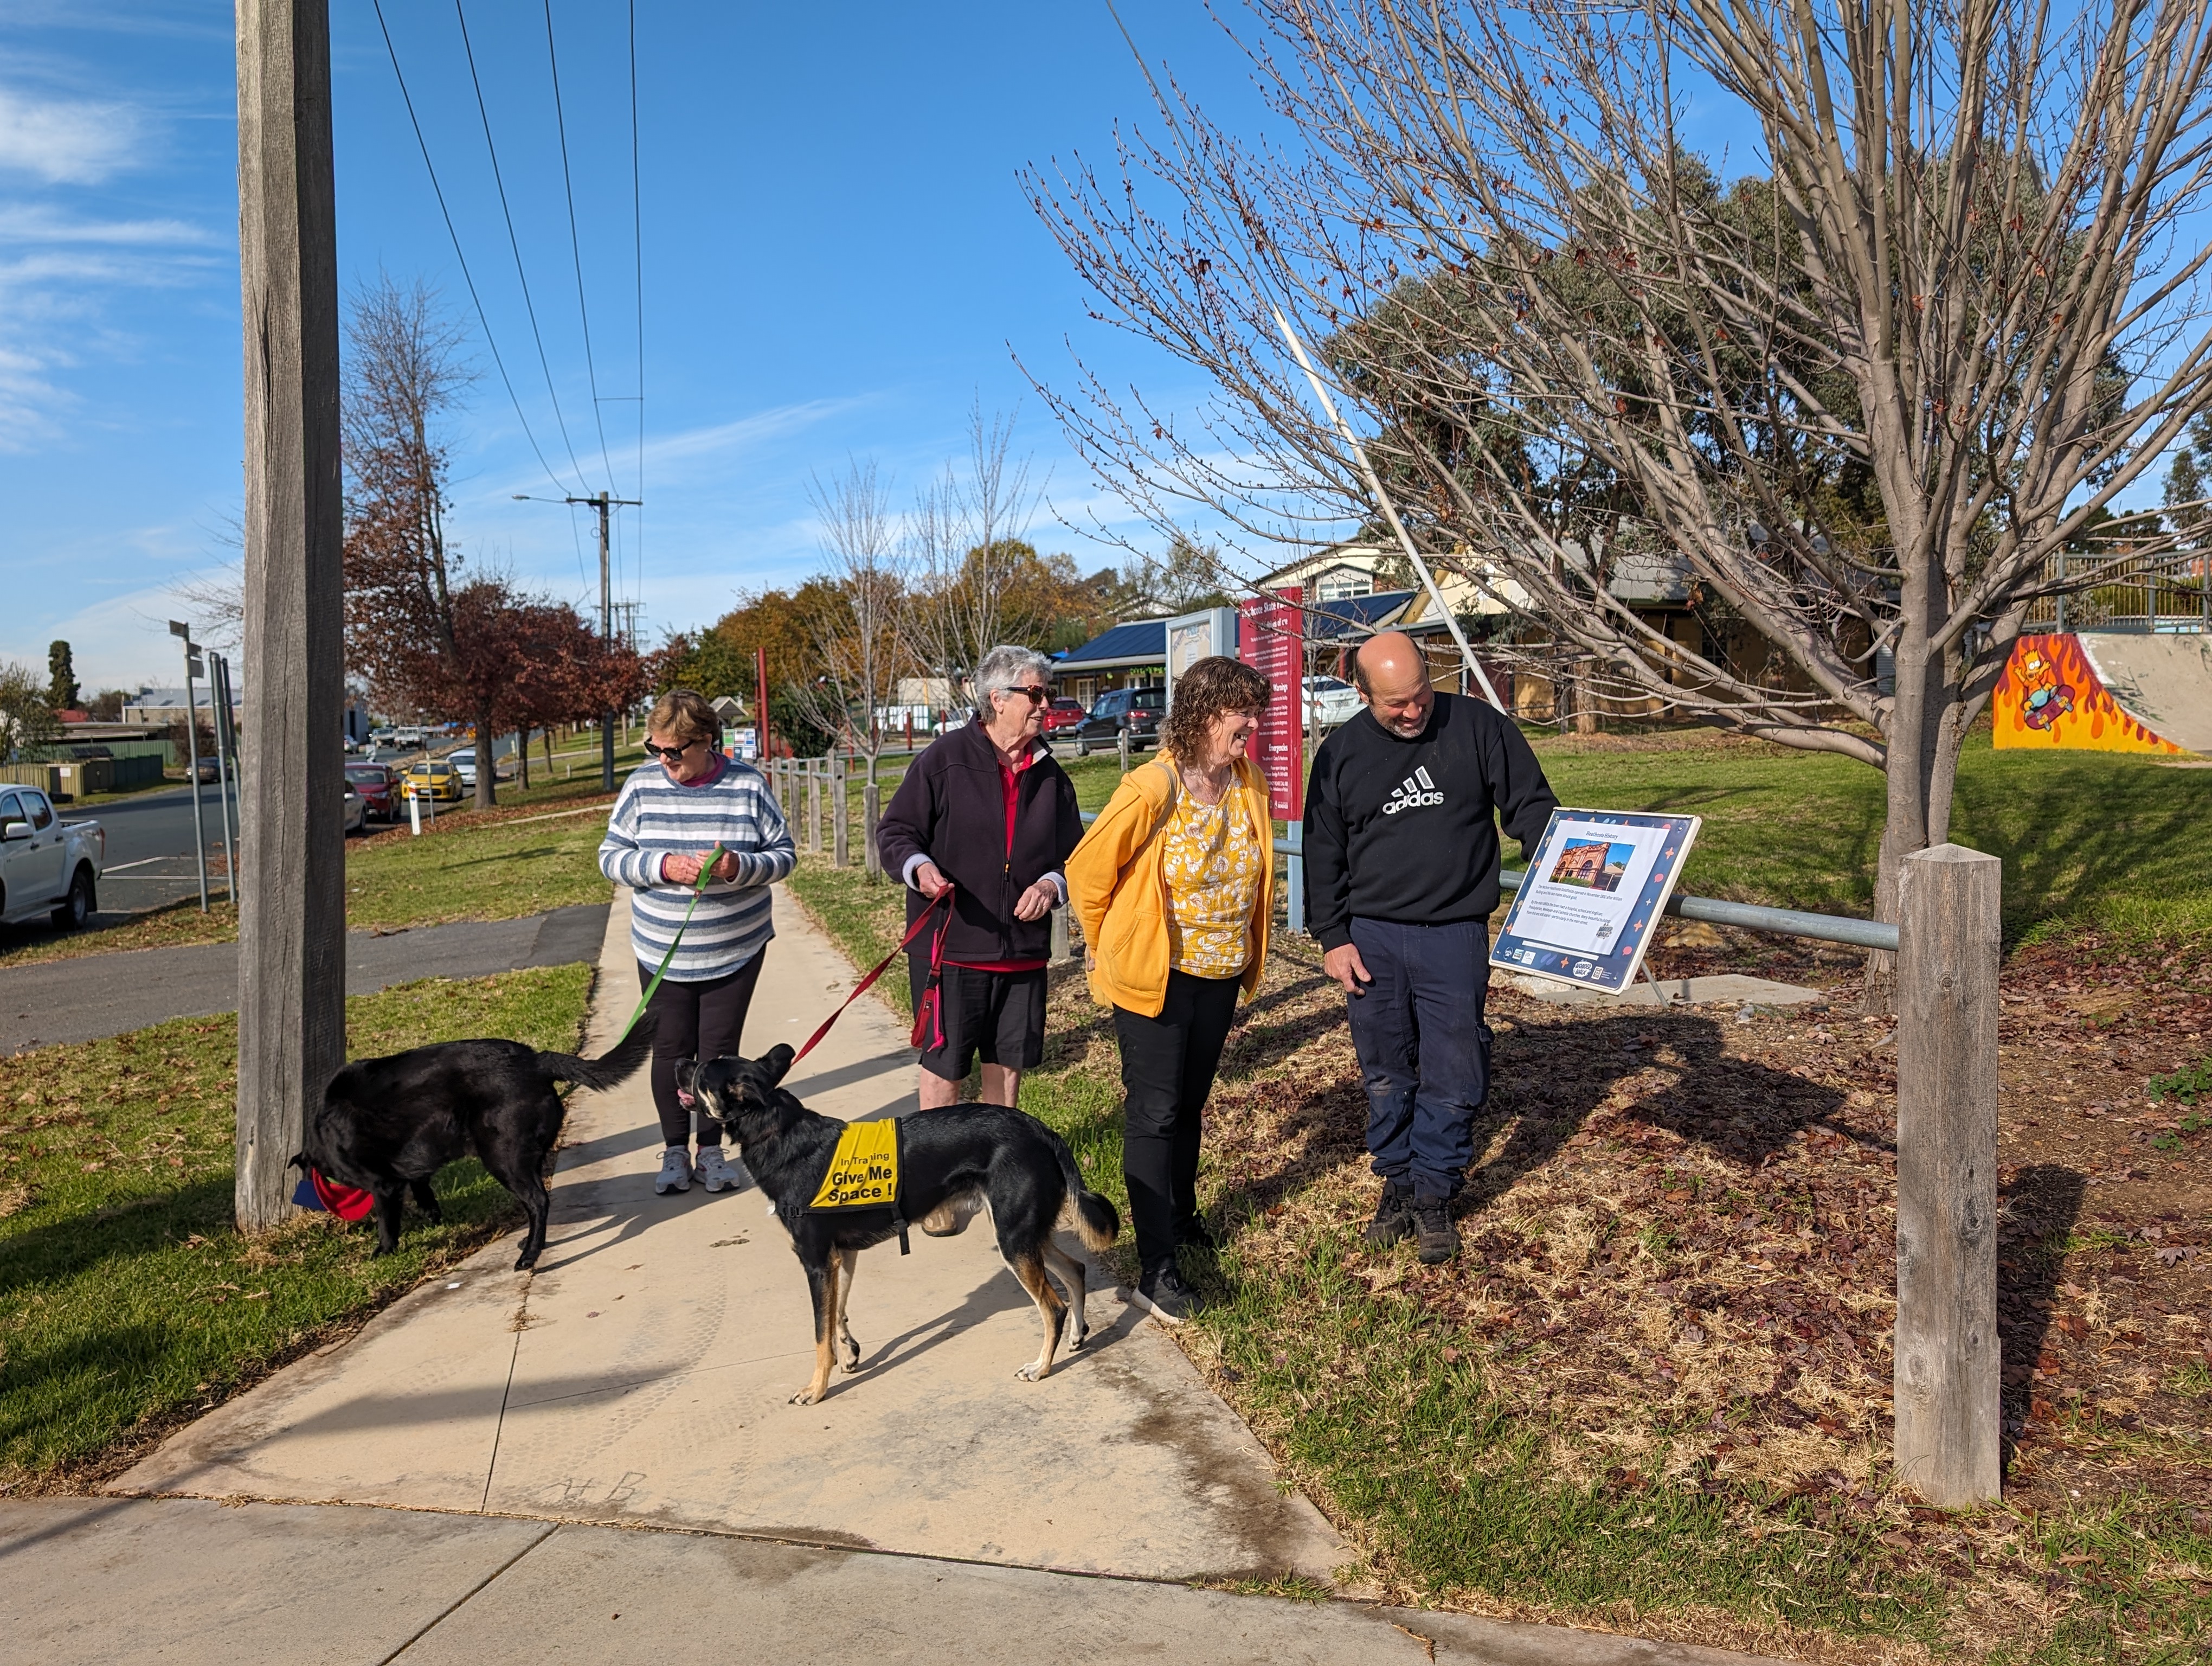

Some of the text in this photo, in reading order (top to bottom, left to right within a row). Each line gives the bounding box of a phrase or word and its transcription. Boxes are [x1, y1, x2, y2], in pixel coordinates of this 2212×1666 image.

[1264, 602, 1276, 613] Skate
[1273, 682, 1288, 693] Warnings
[1269, 742, 1288, 754] Emergencies
[1382, 790, 1444, 815] adidas
[852, 1152, 890, 1165] Traning
[832, 1165, 892, 1186] Give Me
[828, 1183, 892, 1204] Space !
